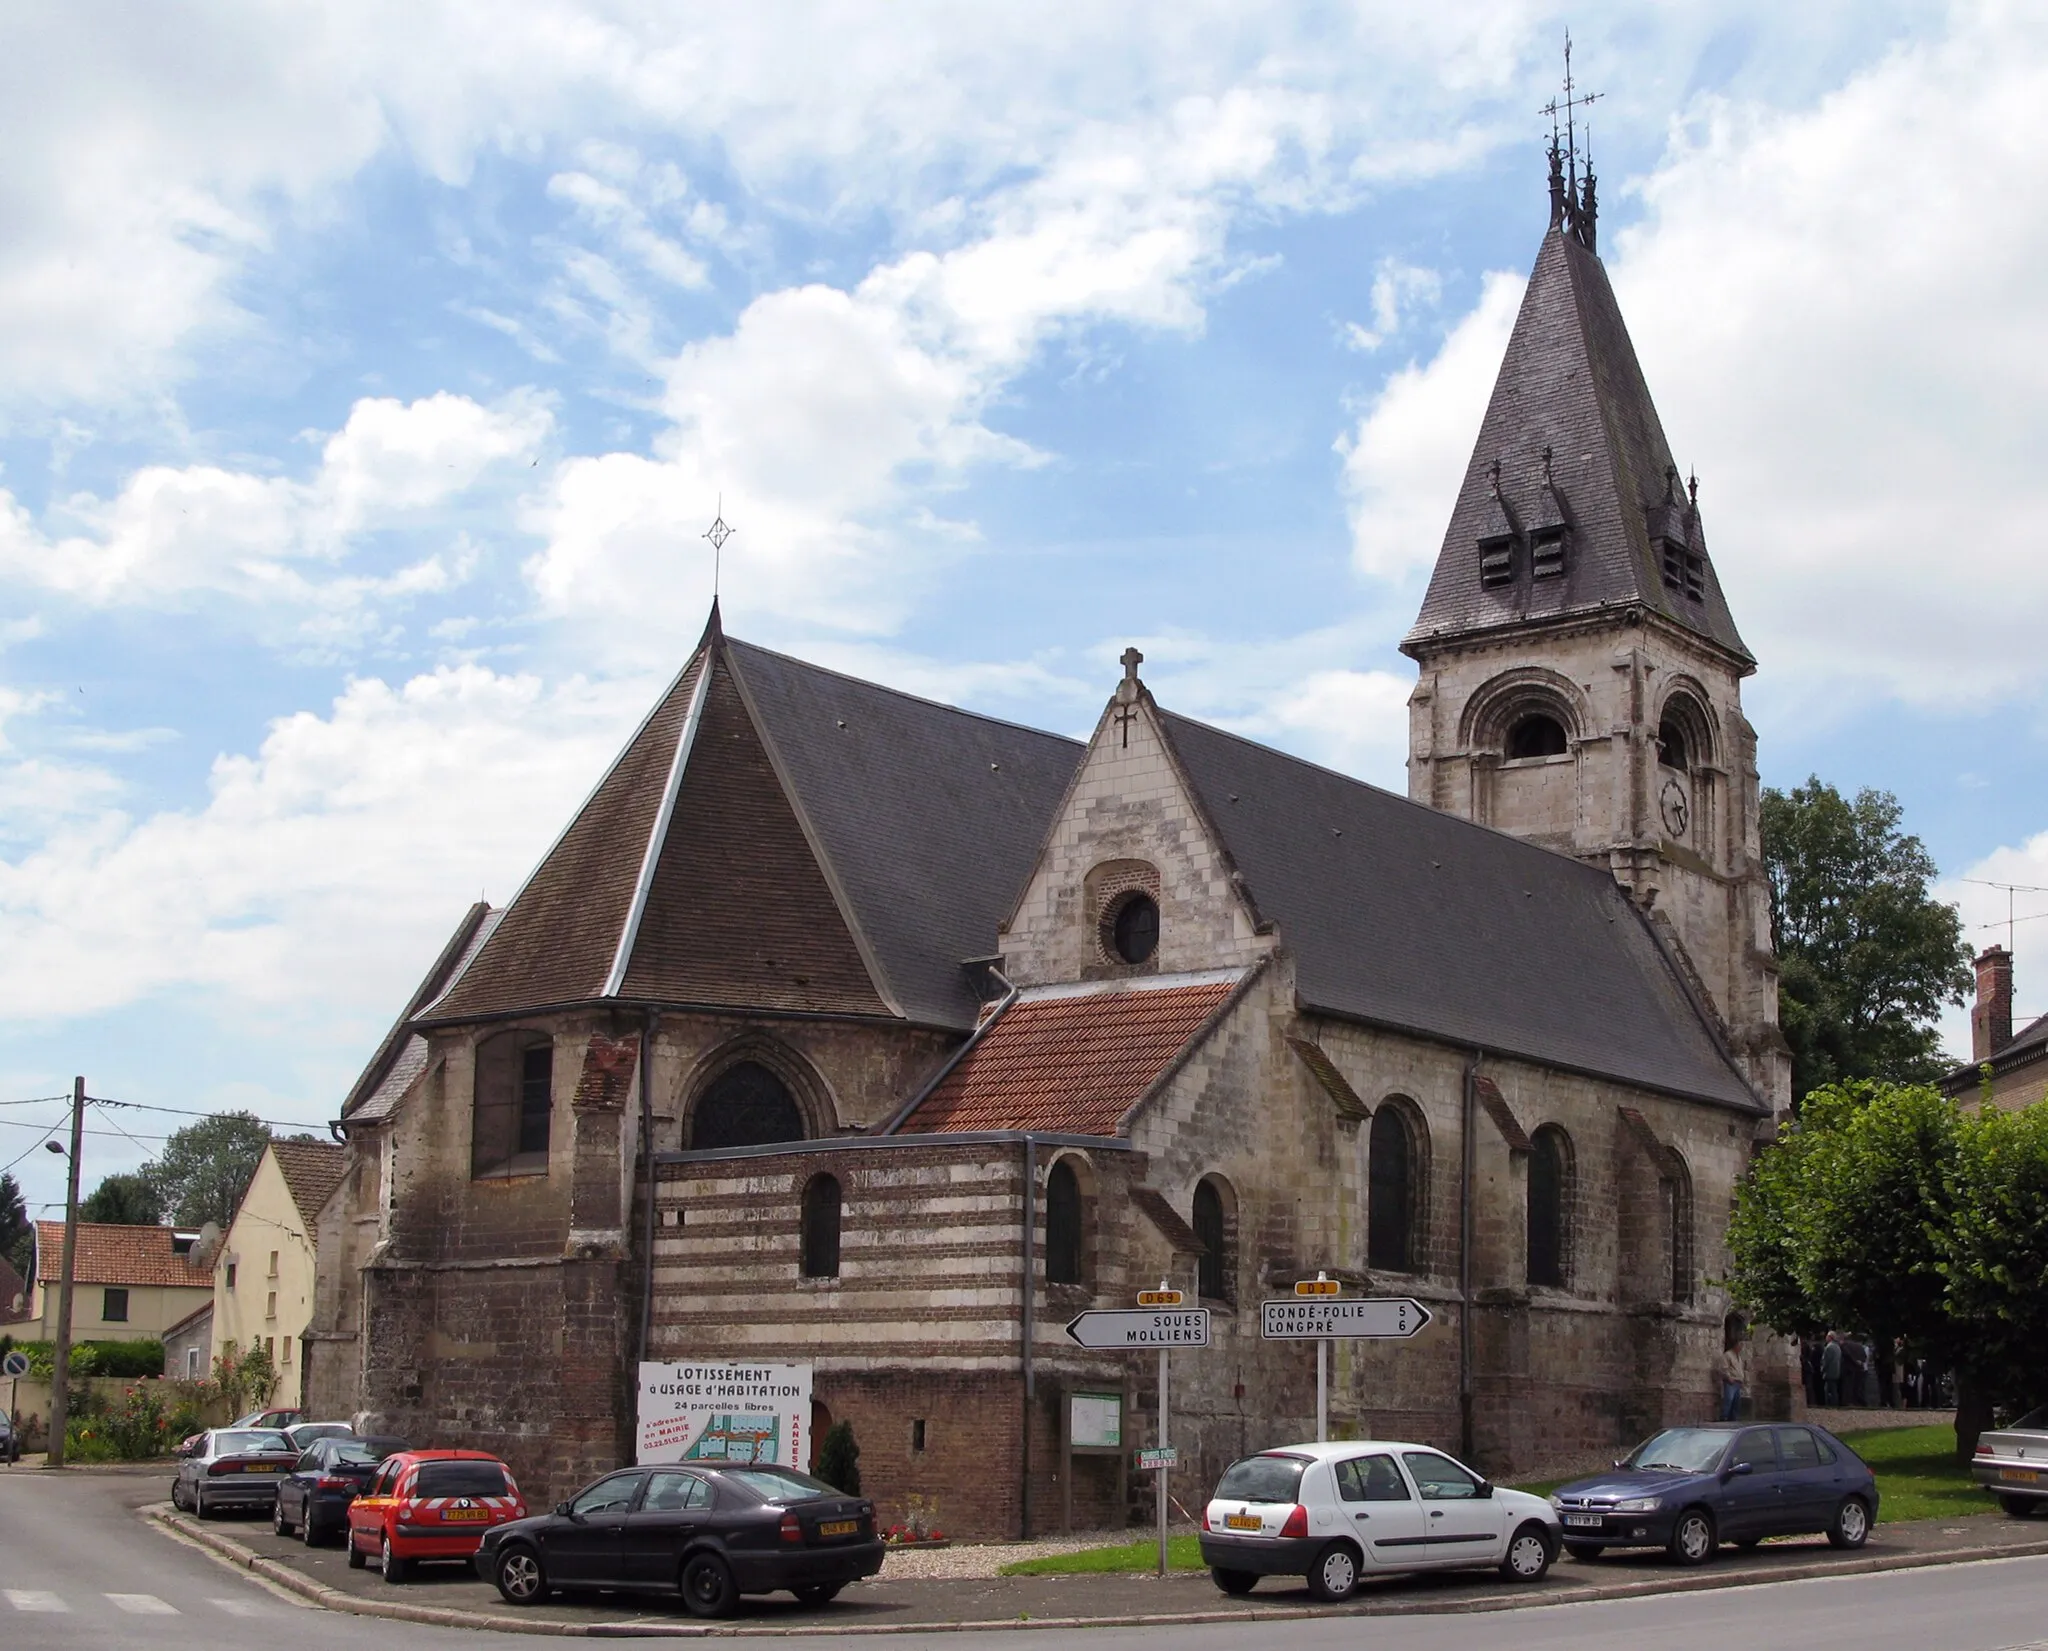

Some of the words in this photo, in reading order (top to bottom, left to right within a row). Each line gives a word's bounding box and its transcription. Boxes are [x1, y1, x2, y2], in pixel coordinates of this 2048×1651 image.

[1308, 1283, 1314, 1294] D
[1319, 1283, 1326, 1294] 3
[1146, 1293, 1153, 1303] D
[1157, 1293, 1174, 1304] 69
[1268, 1305, 1365, 1319] CONDÉ-FOLIE
[1399, 1306, 1406, 1317] 5
[1154, 1315, 1202, 1328] SOUES
[1268, 1319, 1333, 1333] LONGPRÉ
[1398, 1320, 1406, 1331] 6
[1127, 1329, 1202, 1342] MOLLIENS
[677, 1368, 772, 1381] LOTISSEMENT
[650, 1384, 656, 1394] à
[660, 1384, 701, 1395] USAGE
[706, 1384, 800, 1397] d'HABITATION
[674, 1401, 688, 1410] 24
[691, 1401, 740, 1412] parcelles
[745, 1403, 774, 1412] libres
[646, 1414, 688, 1429] s'adresser
[645, 1430, 656, 1439] en
[659, 1424, 690, 1436] MAIRIE
